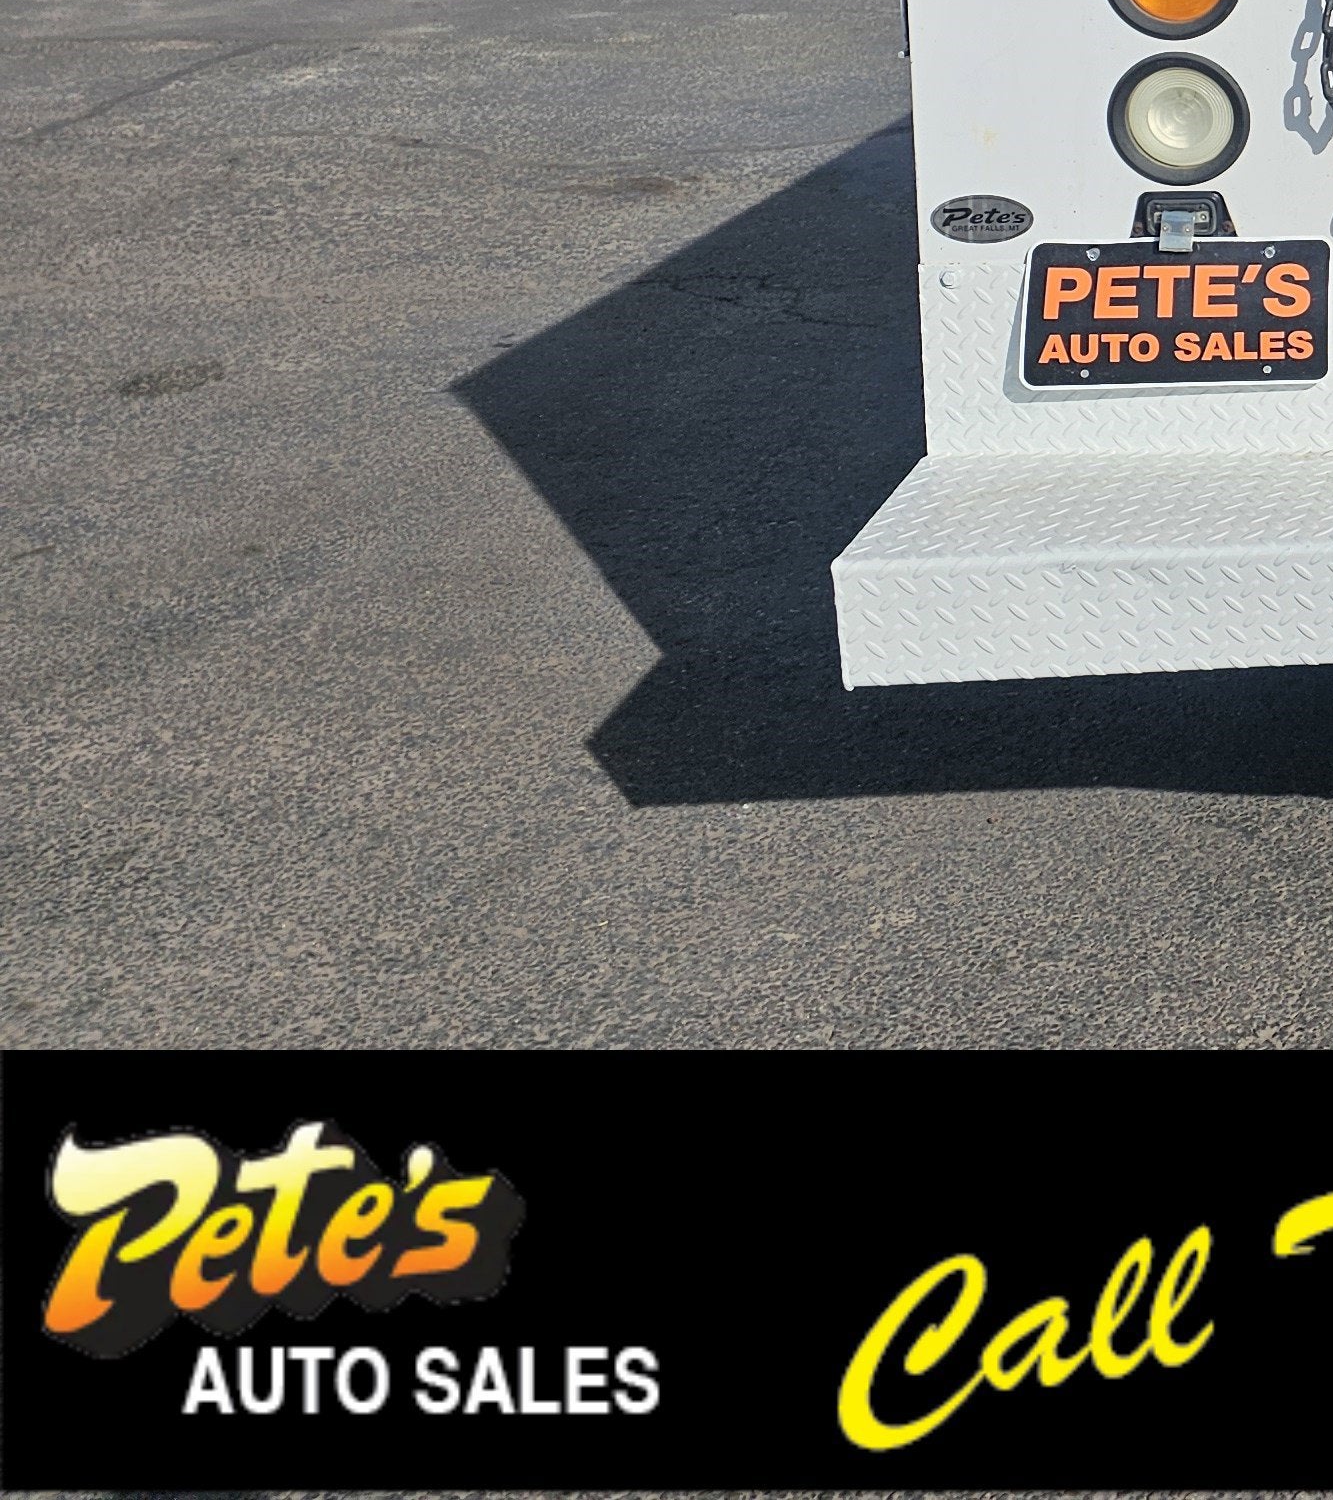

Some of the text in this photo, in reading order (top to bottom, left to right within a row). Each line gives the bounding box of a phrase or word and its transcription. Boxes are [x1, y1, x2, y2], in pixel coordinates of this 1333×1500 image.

[942, 207, 1027, 227] Pete's
[1043, 263, 1311, 320] PETE'S
[1038, 330, 1314, 364] AUTO SALES
